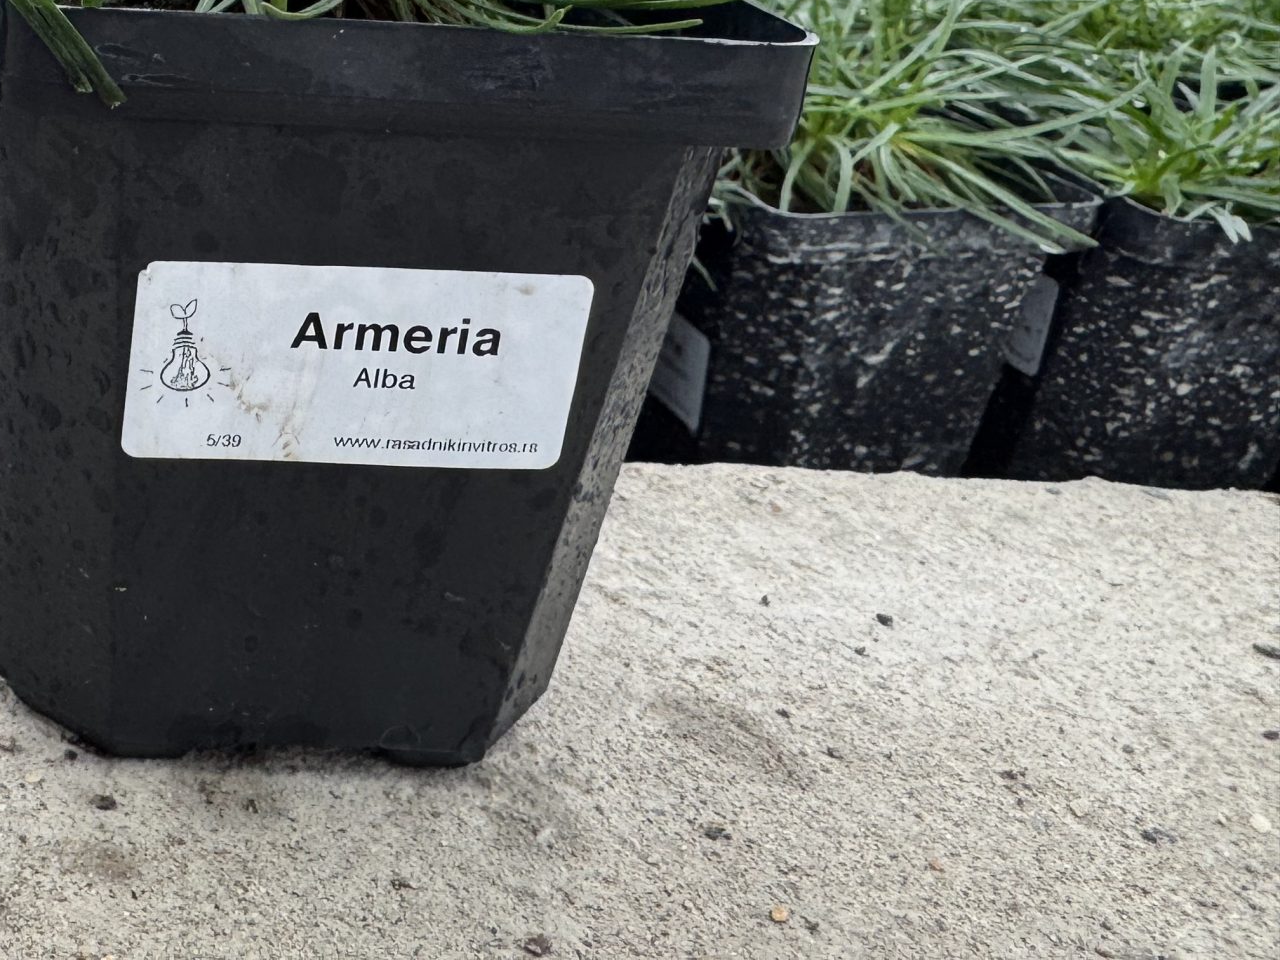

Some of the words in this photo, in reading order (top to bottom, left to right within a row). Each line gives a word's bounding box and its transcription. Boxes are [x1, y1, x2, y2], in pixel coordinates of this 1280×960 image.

[290, 312, 502, 357] Armeria
[352, 367, 416, 390] Alba
[206, 433, 242, 448] 5/39
